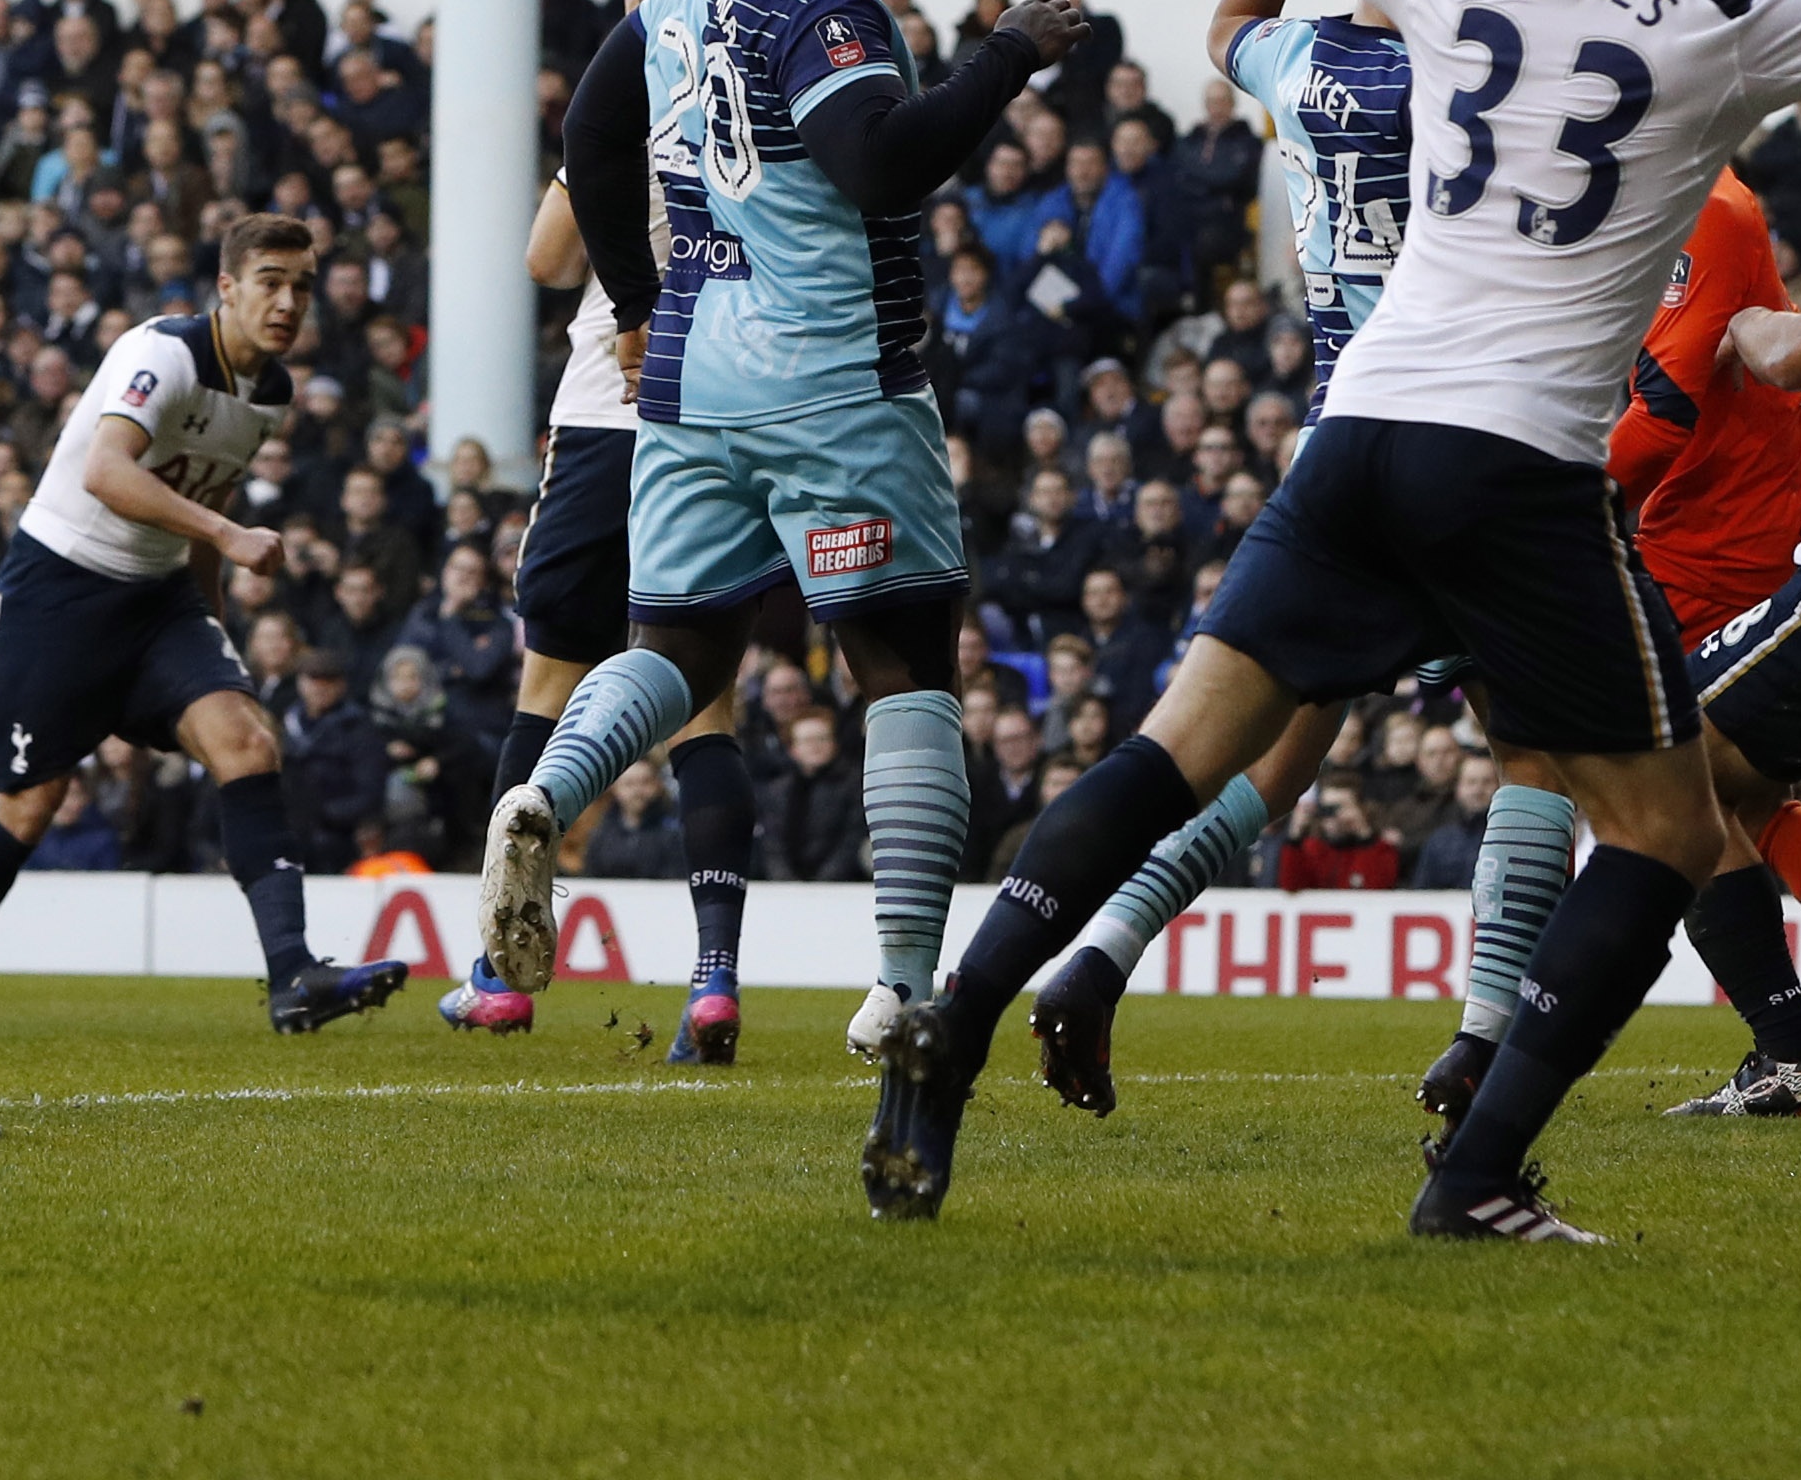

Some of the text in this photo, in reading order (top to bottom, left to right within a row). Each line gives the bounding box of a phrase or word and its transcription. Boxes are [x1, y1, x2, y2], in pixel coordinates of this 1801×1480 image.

[648, 15, 764, 203] 20
[1425, 4, 1657, 249] 33
[811, 524, 886, 551] CHERRY RED
[813, 542, 885, 573] RECORDS
[690, 869, 748, 891] SPURS
[360, 889, 632, 983] AA
[1163, 911, 1356, 996] THE
